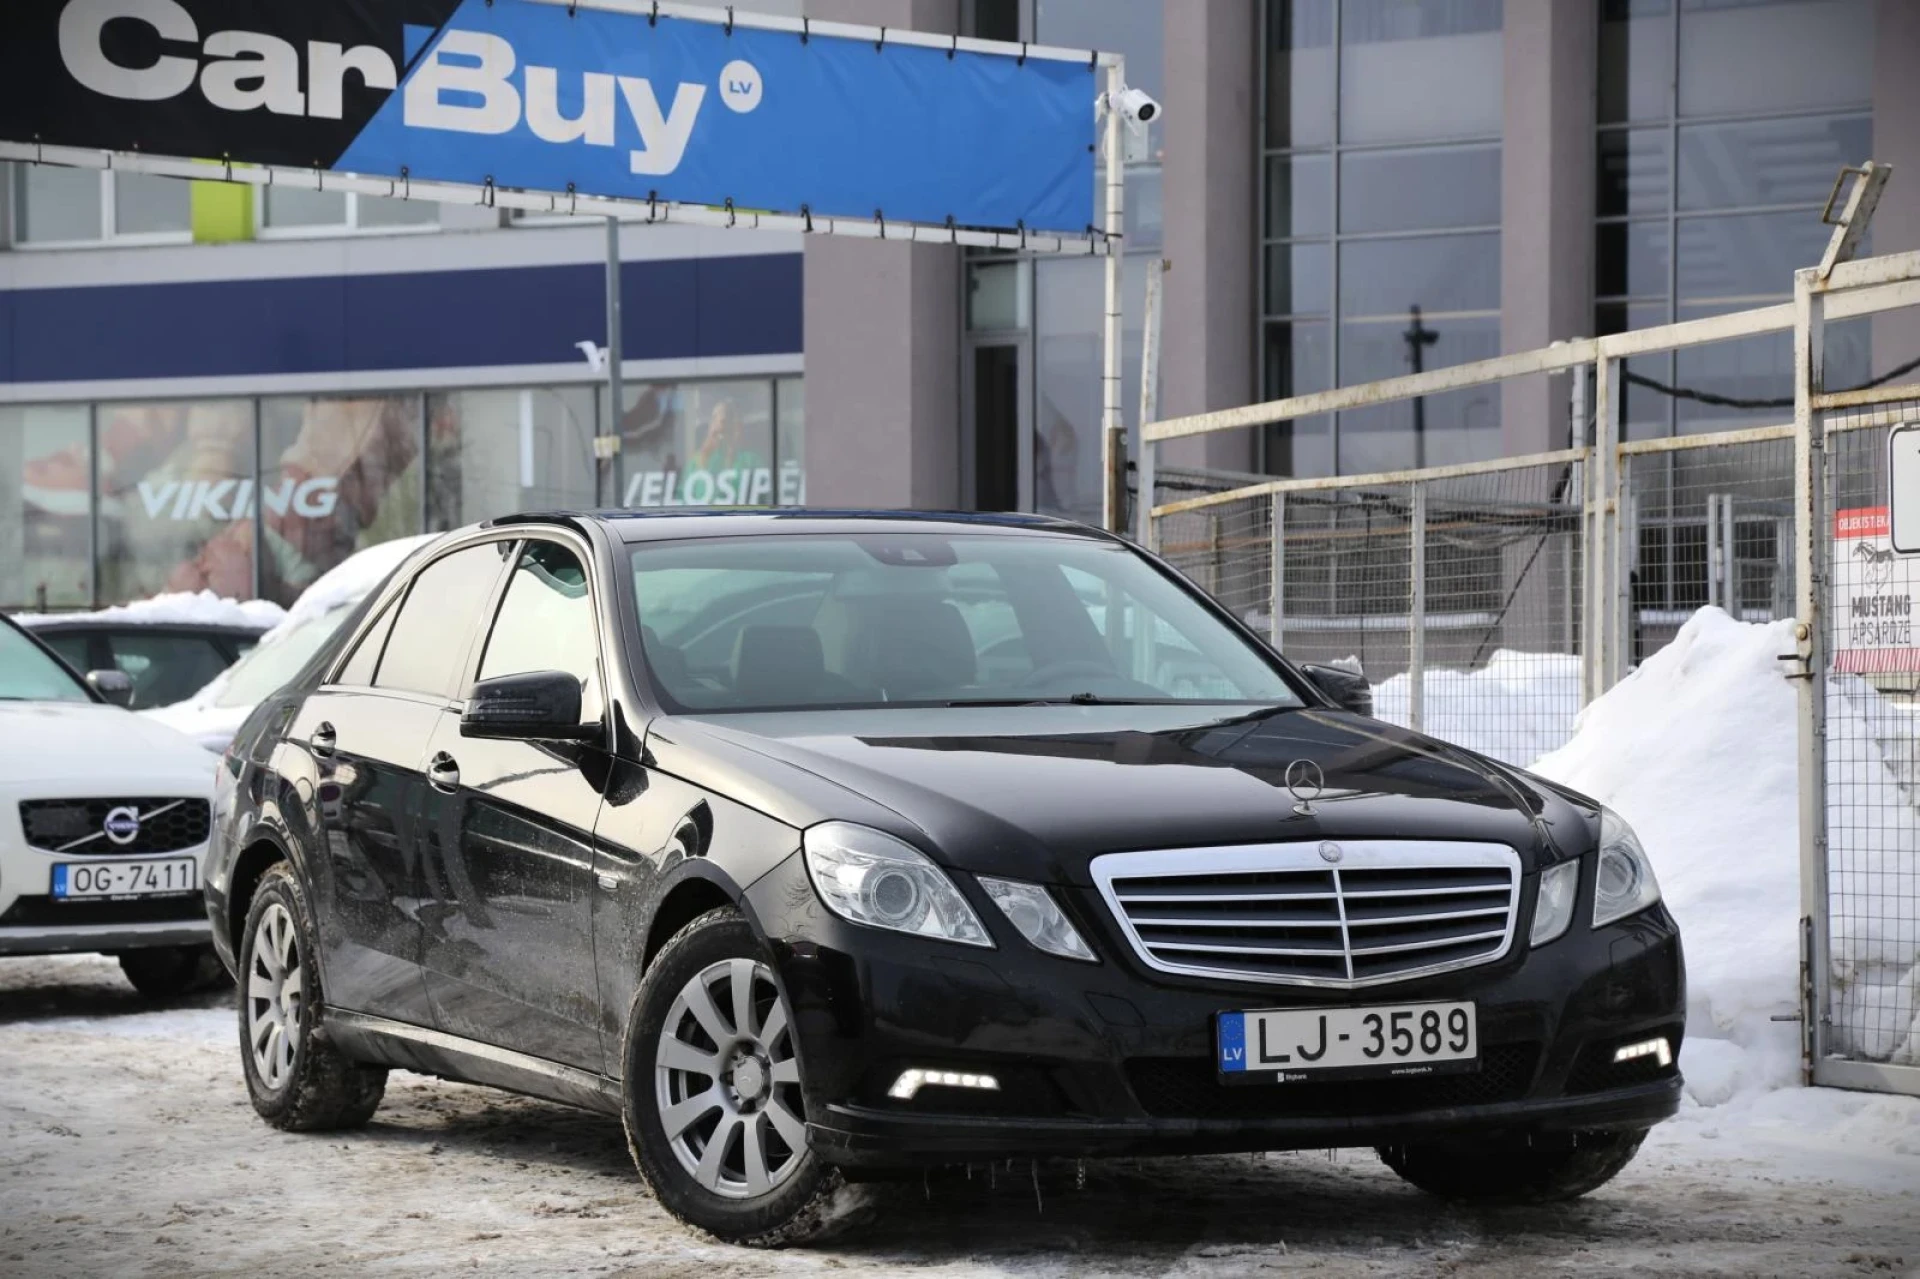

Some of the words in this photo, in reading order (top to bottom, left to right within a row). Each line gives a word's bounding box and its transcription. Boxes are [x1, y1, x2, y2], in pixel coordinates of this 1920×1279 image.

[58, 0, 706, 175] CarBuy
[729, 80, 752, 95] LV
[137, 477, 338, 520] VIKING
[1852, 594, 1910, 618] MUSTANG
[1852, 620, 1910, 645] APSARDZE
[74, 863, 187, 892] OG-7411
[1258, 1008, 1469, 1064] LJ-3589
[1223, 1048, 1242, 1061] LV
